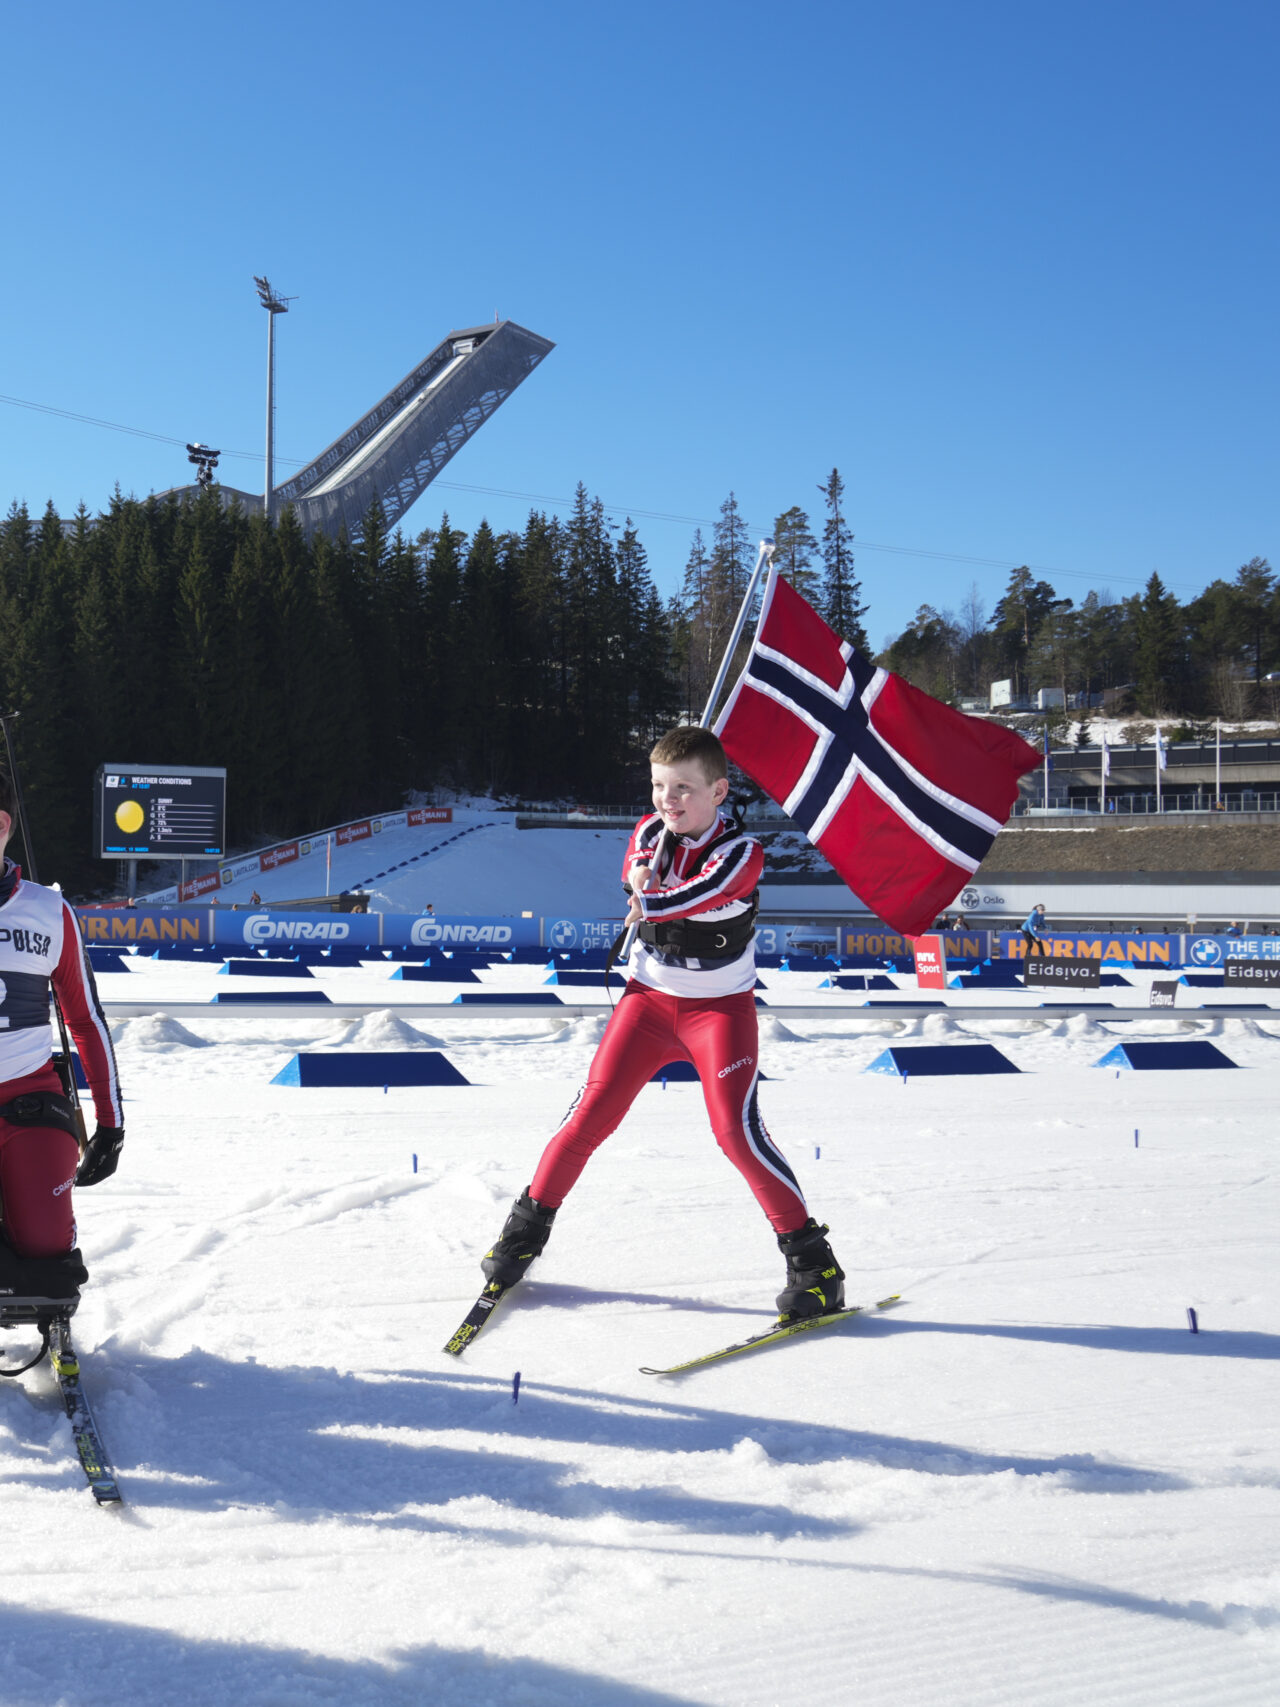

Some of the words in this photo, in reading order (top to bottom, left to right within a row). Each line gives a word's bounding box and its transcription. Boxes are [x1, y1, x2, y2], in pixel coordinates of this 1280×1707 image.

[983, 896, 1005, 904] Oslo
[244, 914, 350, 945] CONRAD
[410, 918, 513, 946] CONRAD
[582, 922, 609, 935] THE
[846, 933, 980, 957] HÖRNN
[1225, 941, 1259, 953] THE
[917, 963, 941, 975] Sport
[1028, 963, 1096, 981] Eidsiva.
[1227, 966, 1280, 982] Eidsiv
[717, 1057, 747, 1078] CRAFT
